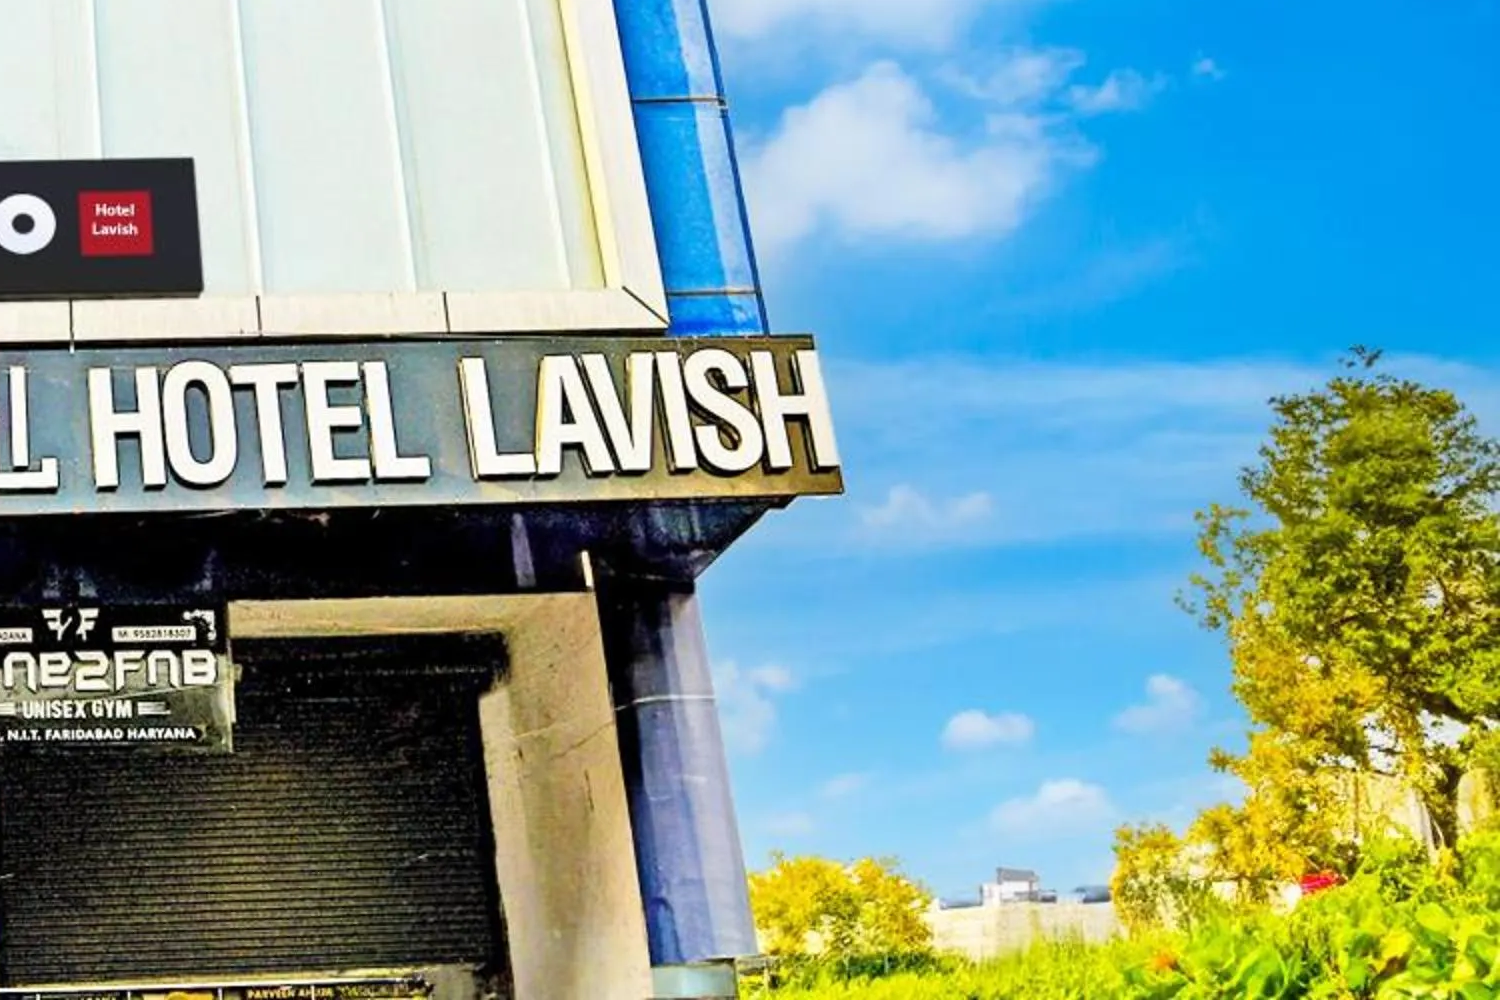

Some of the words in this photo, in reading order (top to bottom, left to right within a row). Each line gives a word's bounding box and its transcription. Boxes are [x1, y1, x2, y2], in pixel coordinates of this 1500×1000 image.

[95, 203, 136, 217] Hotel
[92, 222, 139, 236] Lavish
[88, 358, 432, 491] HOTEL
[458, 347, 841, 482] LAVISH
[21, 700, 86, 719] UNISEX
[91, 699, 133, 718] GYM
[45, 727, 124, 740] FARIDABAD
[127, 726, 197, 739] HARYANA
